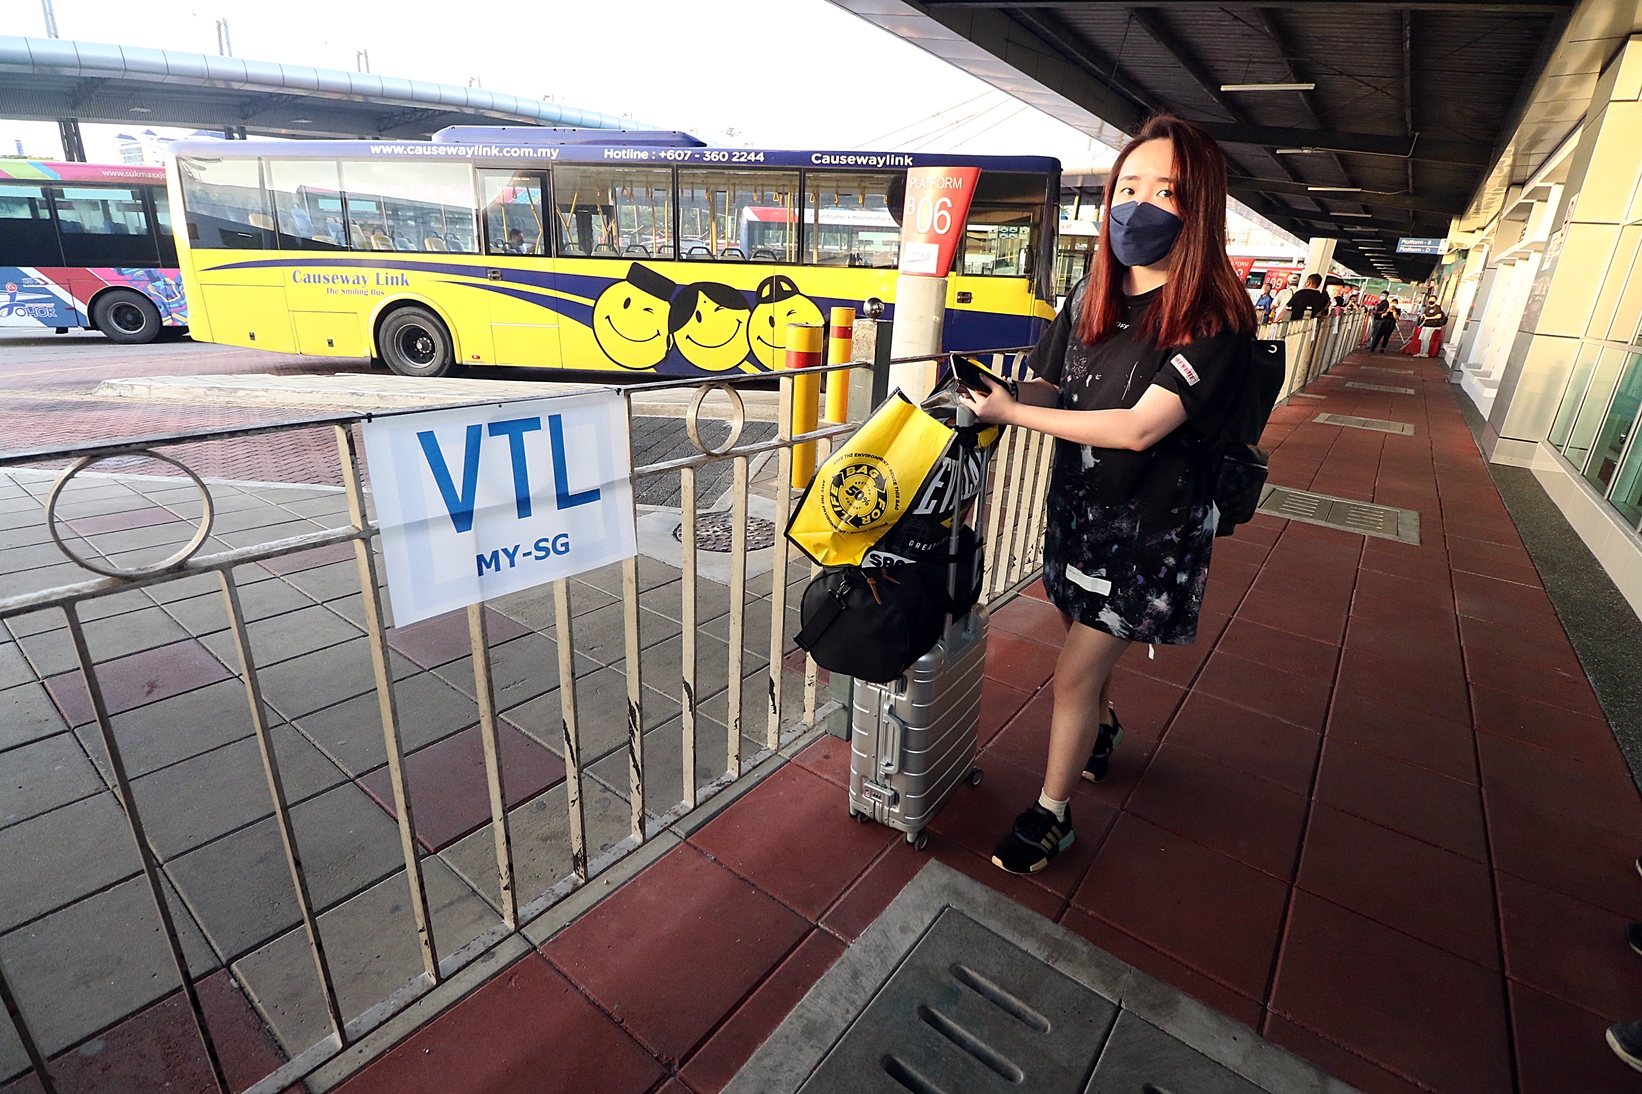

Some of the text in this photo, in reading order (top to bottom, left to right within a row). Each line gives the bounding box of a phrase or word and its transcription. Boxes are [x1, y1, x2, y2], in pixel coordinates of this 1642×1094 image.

[370, 144, 559, 160] www.causewaylink.com.my
[603, 149, 649, 160] Hotline
[659, 150, 693, 161] +607
[703, 151, 729, 162] 360
[731, 151, 765, 163] 2244
[811, 153, 913, 168] Causewaylink
[909, 177, 963, 190] PLATFORM
[292, 270, 410, 288] Causeway Link
[326, 287, 385, 297] The Smiling Bus
[416, 413, 601, 534] VTL
[830, 464, 886, 525] BAG FOR LIFE
[845, 484, 871, 507] 50%
[476, 533, 570, 577] MY-SG
